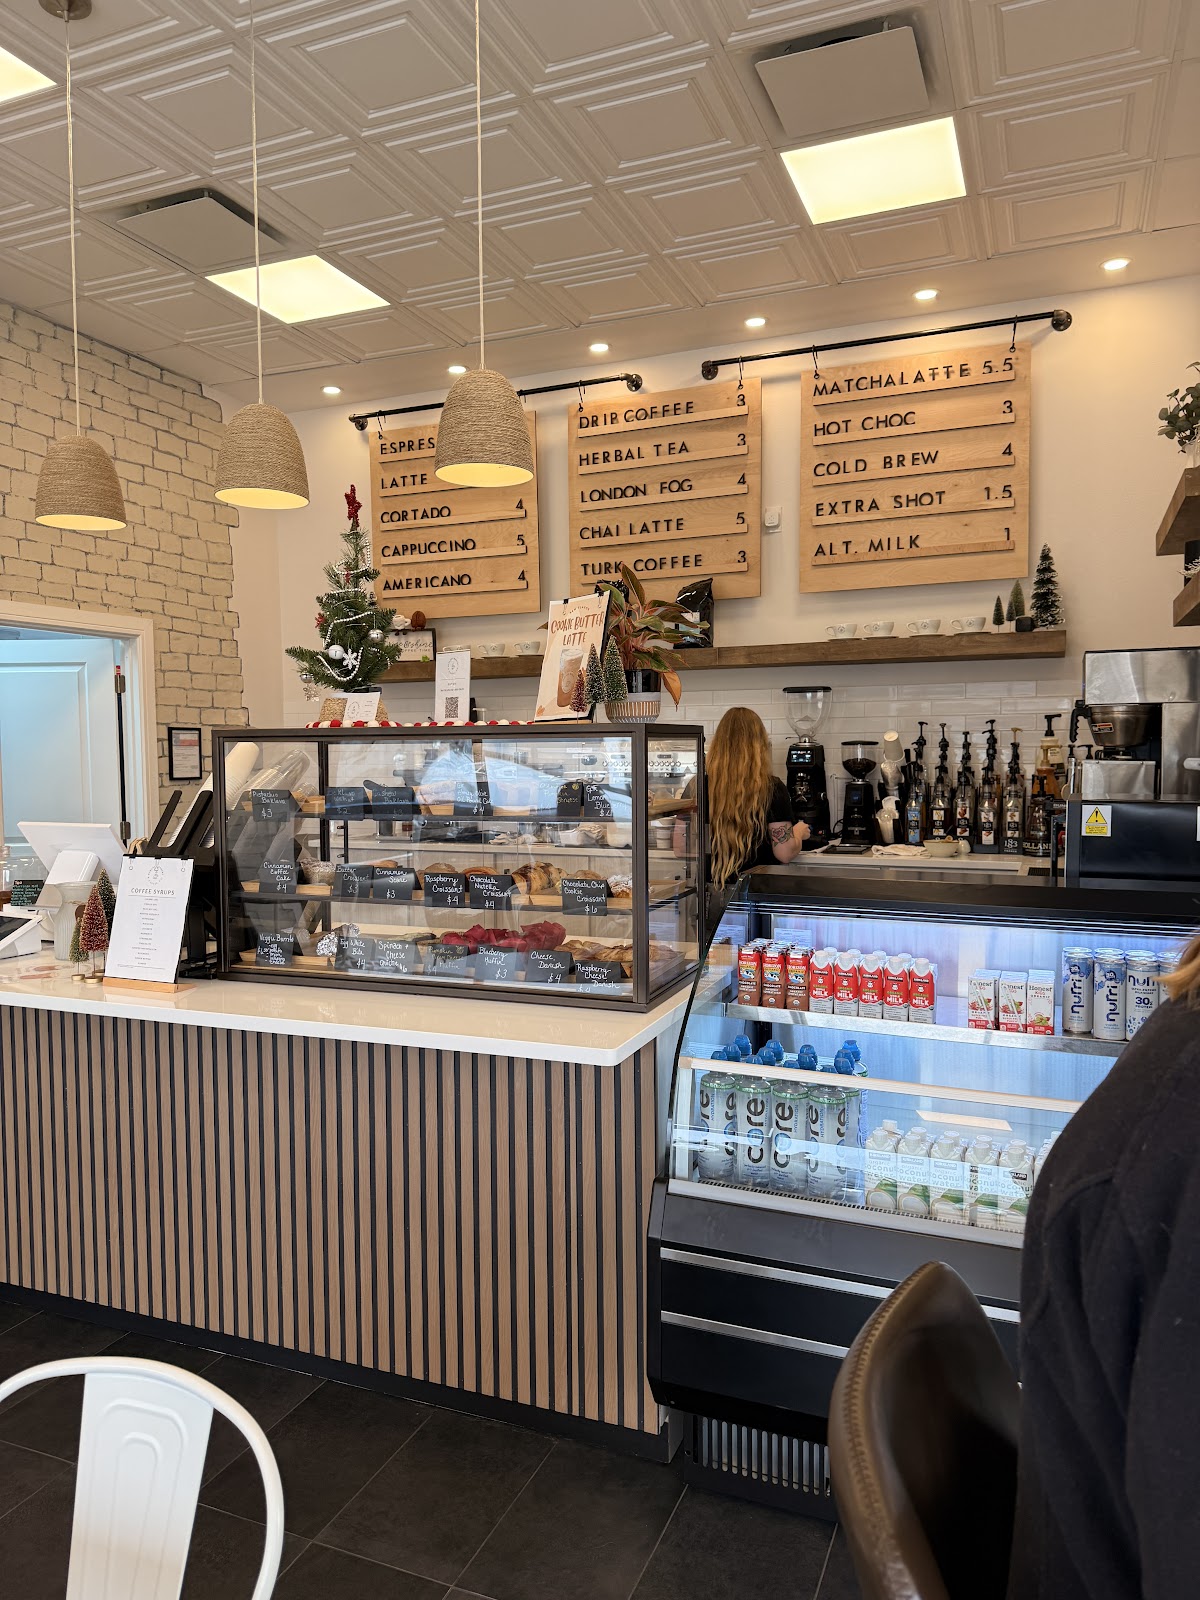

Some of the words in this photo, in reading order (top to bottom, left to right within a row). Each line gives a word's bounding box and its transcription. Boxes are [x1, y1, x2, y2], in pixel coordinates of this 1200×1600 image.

[578, 412, 619, 429] DRIP
[623, 401, 695, 422] COFFEE
[736, 394, 746, 407] 3
[814, 419, 852, 437] HOT
[861, 411, 916, 431] CHOC
[1002, 400, 1013, 414] 3
[380, 436, 435, 456] ESPRES
[579, 446, 645, 466] HERBAL
[653, 441, 690, 456] TEA
[736, 433, 747, 447] 3
[813, 458, 868, 477] COLD
[883, 450, 939, 469] BREW
[1002, 442, 1013, 456] 4
[380, 473, 429, 490] LATTE
[580, 483, 647, 503] LONDON
[659, 478, 693, 494] FOG
[736, 473, 747, 486] 4
[815, 498, 880, 517] EXTRA
[893, 491, 946, 509] SHOT
[984, 485, 1012, 500] 1.5
[380, 506, 451, 524] CORTADO
[515, 499, 525, 512] 4
[579, 525, 620, 541] CHAI
[629, 518, 685, 536] LATTE
[735, 512, 745, 525] 5
[380, 538, 476, 558] CAPPUCCINO
[516, 534, 525, 547] 5
[814, 540, 858, 557] ALT.
[868, 535, 920, 553] MILK
[1003, 527, 1011, 541] 1
[580, 560, 624, 576] TURK
[634, 554, 703, 573] COFFEE
[736, 550, 747, 564] 3
[382, 573, 472, 592] AMERICANO
[516, 569, 526, 582] 4
[551, 618, 573, 634] COOKIE
[574, 611, 605, 630] BUTTER
[563, 631, 587, 646] LATTE
[261, 807, 273, 819] $3
[473, 806, 485, 815] $4
[263, 861, 294, 870] Cinnamon
[375, 868, 408, 876] Cinnamon
[424, 874, 459, 886] Raspberry
[469, 875, 498, 884] Chocolate
[562, 880, 591, 888] Chocolate
[591, 881, 605, 889] Chip
[276, 884, 287, 893] $4
[432, 885, 463, 893] Croissant
[474, 883, 500, 891] Nutella
[564, 887, 583, 895] Cookie
[386, 890, 396, 899] $3
[482, 889, 512, 898] Croissant
[576, 894, 606, 903] Croissant
[446, 895, 459, 905] $4
[484, 899, 495, 909] $4
[340, 939, 350, 949] Egg
[378, 941, 403, 950] Spinach
[385, 950, 406, 959] Cheese
[478, 946, 508, 958] Blueberry
[530, 951, 554, 960] Cheese
[356, 959, 366, 970] $4
[484, 957, 505, 966] Muffin
[538, 960, 565, 969] Danish
[576, 963, 612, 973] Raspberry
[495, 969, 508, 980] $3
[548, 974, 562, 984] $4
[584, 972, 608, 980] Cheese
[592, 979, 620, 989] Danish
[886, 996, 903, 1004] MILK
[746, 1097, 765, 1163] core
[773, 1102, 793, 1168] core
